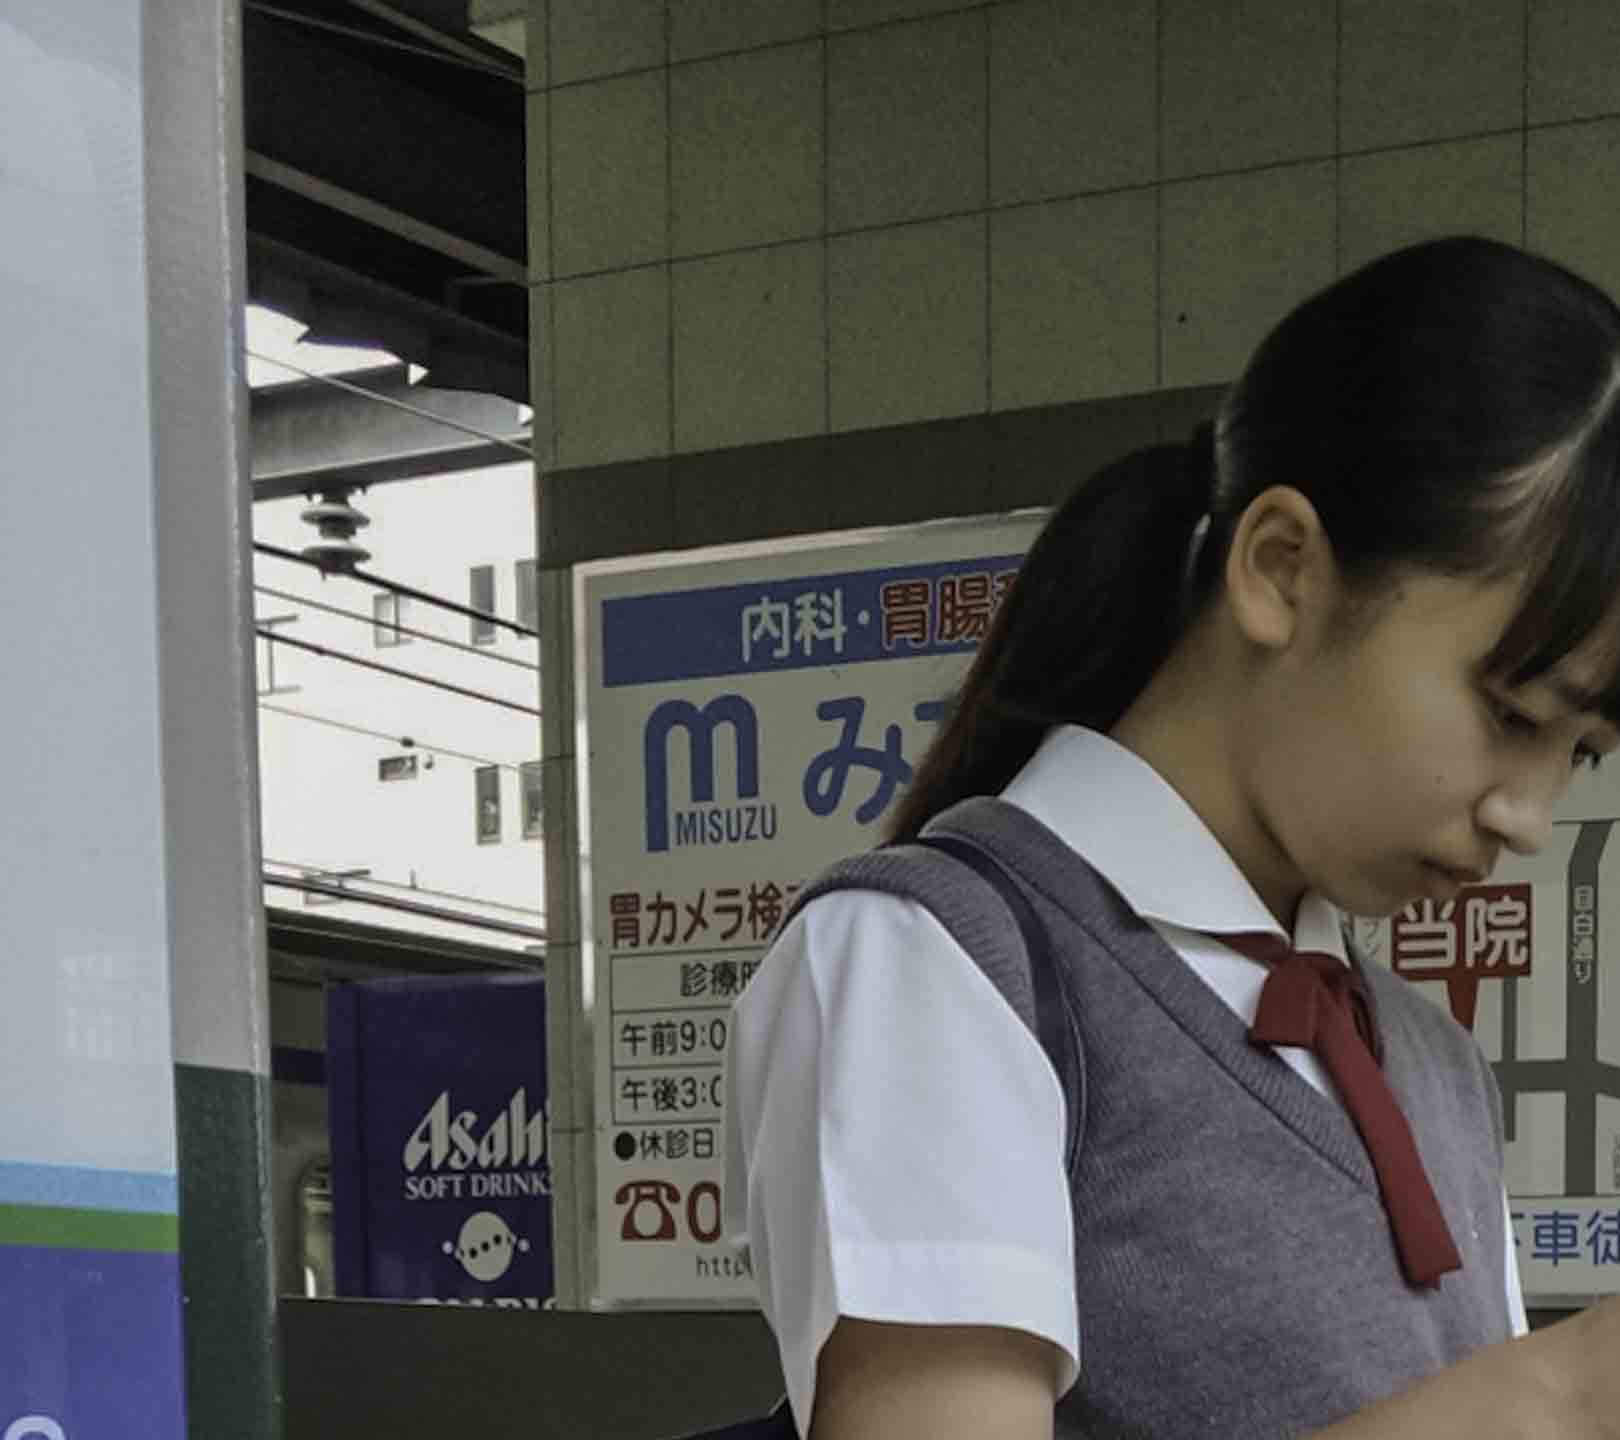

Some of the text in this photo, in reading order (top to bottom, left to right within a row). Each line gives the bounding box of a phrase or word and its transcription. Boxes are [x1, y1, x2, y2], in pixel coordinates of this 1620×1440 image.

[675, 804, 778, 847] MISUZU
[610, 881, 801, 949] 胃カメラ検
[1397, 895, 1529, 969] 当院
[403, 1086, 551, 1172] Asah
[405, 1171, 553, 1200] SOFT DRINK
